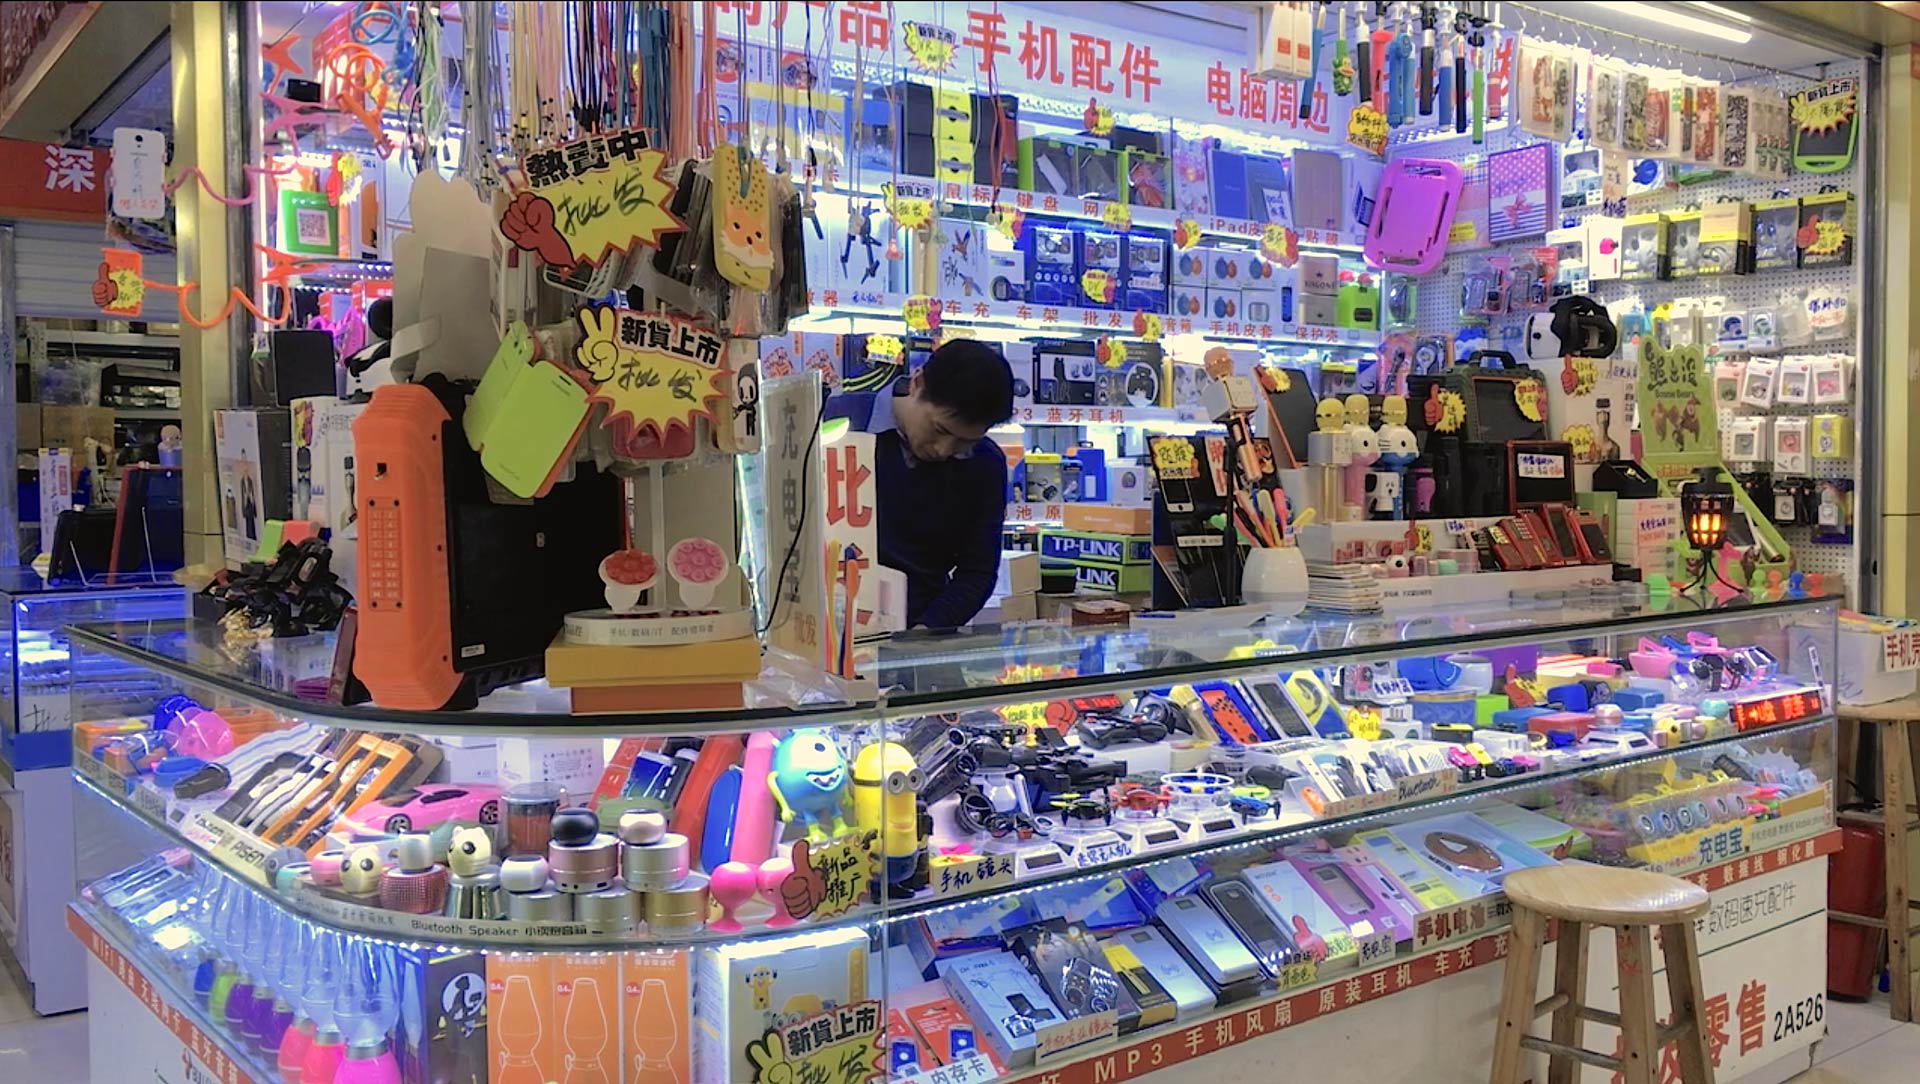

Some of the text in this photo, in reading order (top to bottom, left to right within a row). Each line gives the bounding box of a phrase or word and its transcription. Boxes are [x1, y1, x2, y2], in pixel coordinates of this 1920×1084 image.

[962, 10, 1161, 103] 手机配件
[1206, 60, 1331, 134] 电脑周边
[45, 144, 95, 193] 深
[526, 129, 649, 189] 熱賣中
[944, 182, 992, 203] 鼠标
[1016, 191, 1059, 212] 键盘
[945, 300, 991, 318] 车充
[1015, 305, 1060, 322] 车架
[1081, 311, 1123, 328] 批发
[1208, 321, 1274, 338] 手机皮套
[621, 315, 722, 368] 新貨上市
[1046, 407, 1125, 423] 蓝牙耳机
[1052, 536, 1122, 557] TP-LINK
[1699, 826, 1743, 866] 充电宝
[940, 856, 1014, 893] 手机镜头
[411, 919, 463, 935] Bluetooth
[468, 924, 519, 938] Speaker
[1417, 903, 1486, 946] 手机电池
[787, 1007, 876, 1056] 新貨上市
[1094, 1043, 1164, 1084] MP3
[1185, 1000, 1292, 1055] 手机风扇
[1319, 964, 1412, 1013] 原装耳机
[1435, 946, 1473, 976] 车充
[1773, 993, 1824, 1043] 2A526
